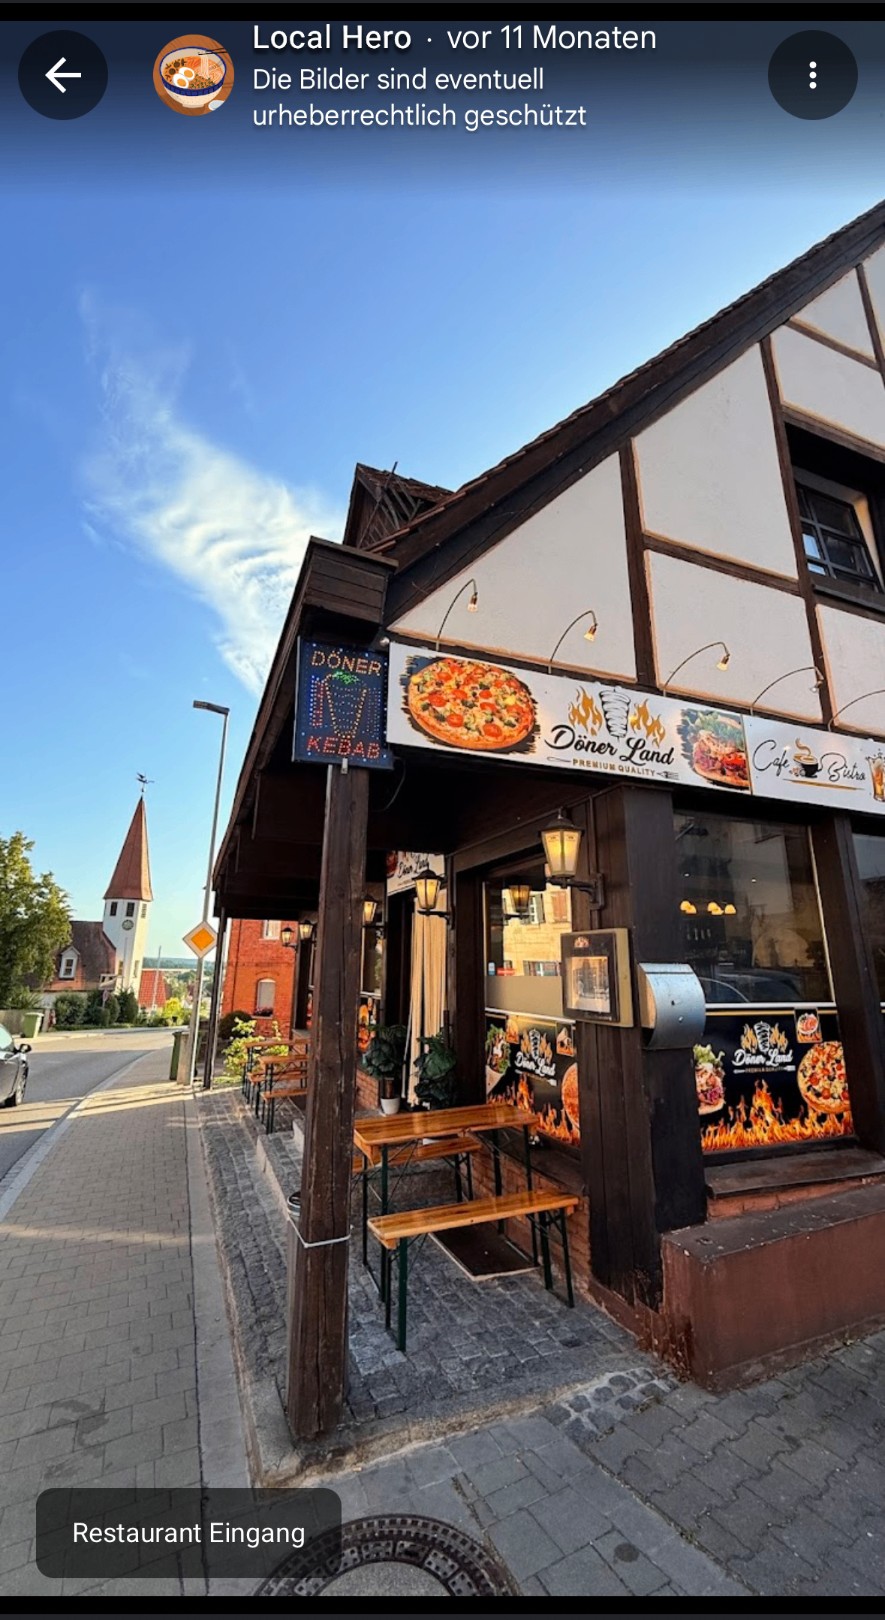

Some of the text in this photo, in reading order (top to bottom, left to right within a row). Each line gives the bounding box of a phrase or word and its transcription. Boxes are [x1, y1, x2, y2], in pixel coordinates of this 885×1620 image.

[311, 650, 382, 676] DÖNER
[307, 735, 380, 759] KEBAB
[544, 724, 674, 767] Döner Land
[572, 758, 656, 777] PREMIUM QUALITY
[819, 752, 866, 782] Bistro
[731, 1048, 794, 1067] Döner Land
